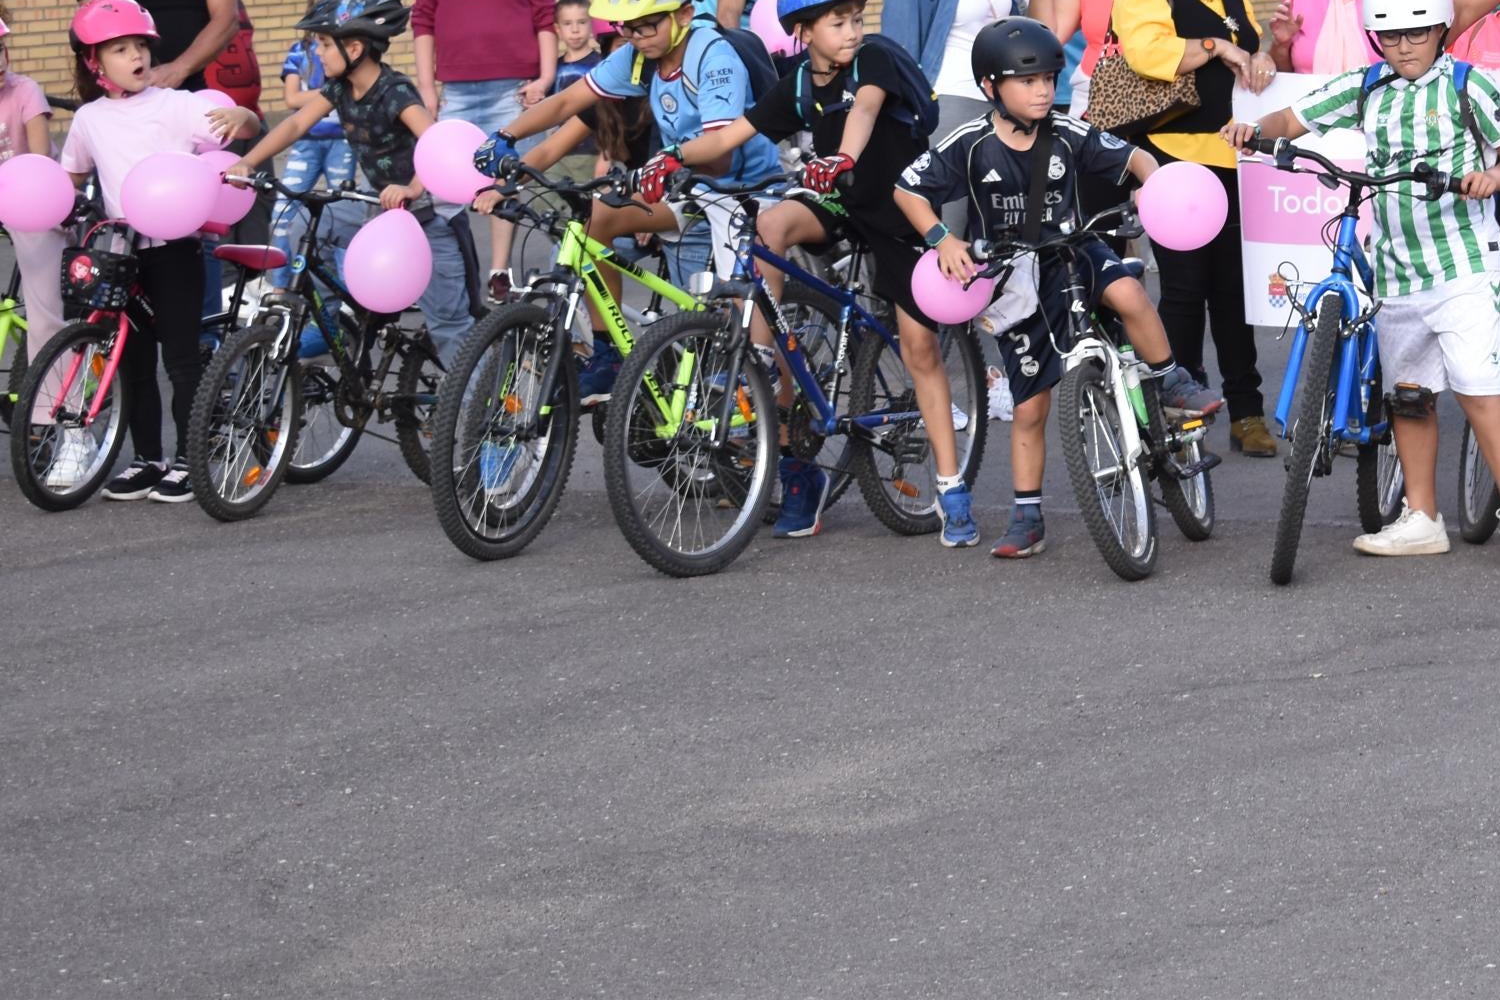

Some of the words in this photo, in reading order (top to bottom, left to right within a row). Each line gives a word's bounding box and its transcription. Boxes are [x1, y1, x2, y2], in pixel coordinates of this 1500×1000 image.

[990, 189, 1064, 210] Emies
[1267, 185, 1349, 215] Todo
[1004, 210, 1021, 225] FLY
